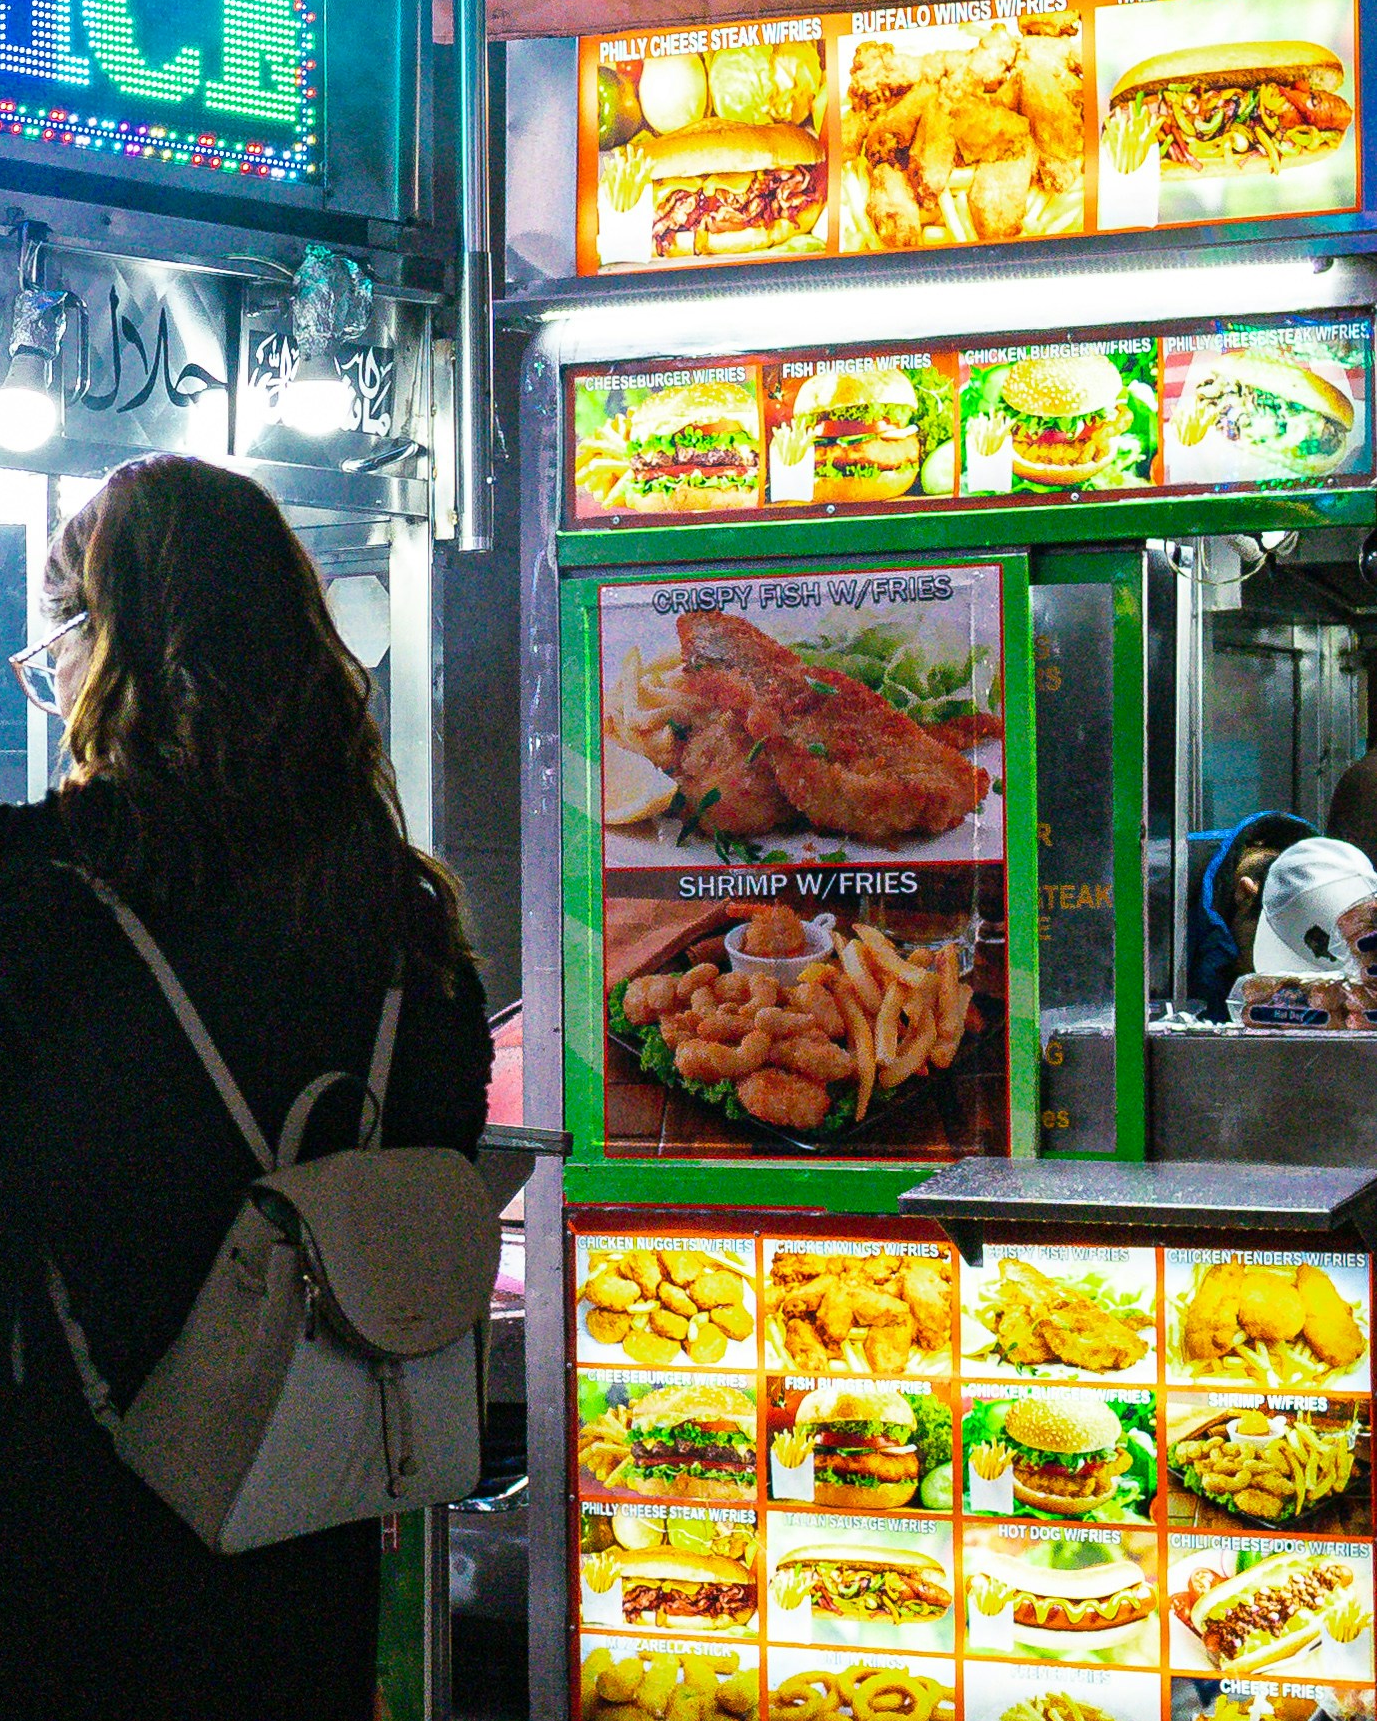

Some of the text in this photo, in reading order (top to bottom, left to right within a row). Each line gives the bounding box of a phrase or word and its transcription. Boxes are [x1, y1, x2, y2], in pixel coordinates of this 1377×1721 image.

[852, 6, 930, 33] BUFFALO
[934, 1, 992, 24] WINGS
[600, 18, 823, 63] PHILLY CHEESE STEAK W/FRIES
[964, 337, 1151, 365] CHICKEN BURGER W/FRIES
[1168, 328, 1313, 353] PHILLY STEAK
[783, 353, 932, 378] FISH BURGER W/FRIES
[586, 367, 746, 391] CHEESEBURGER W/FRIES
[652, 573, 954, 617] CRISPY FISH W/FRIES
[679, 870, 919, 899] SHRIMP W/FRIES
[578, 1236, 753, 1252] CHICKEN NUGGETS W/FRIES
[775, 1240, 939, 1257] CHICKEN WINGS W/FRIES
[1038, 1247, 1067, 1260] FISH
[1168, 1250, 1366, 1267] CHICKEN TENDERS W/FRIES
[785, 1376, 815, 1391] FISH
[1208, 1393, 1328, 1411] SHRIMP W/FRIES
[582, 1501, 756, 1524] PHILLY CHEESE STEAK W/FRIES
[829, 1515, 886, 1531] SAUSAGE
[998, 1524, 1121, 1544] HOT DOG W/FRIES
[1170, 1534, 1369, 1558] CHILI CHEESE DOG W/FRIES
[1220, 1678, 1325, 1700] CHEESE FRIES
